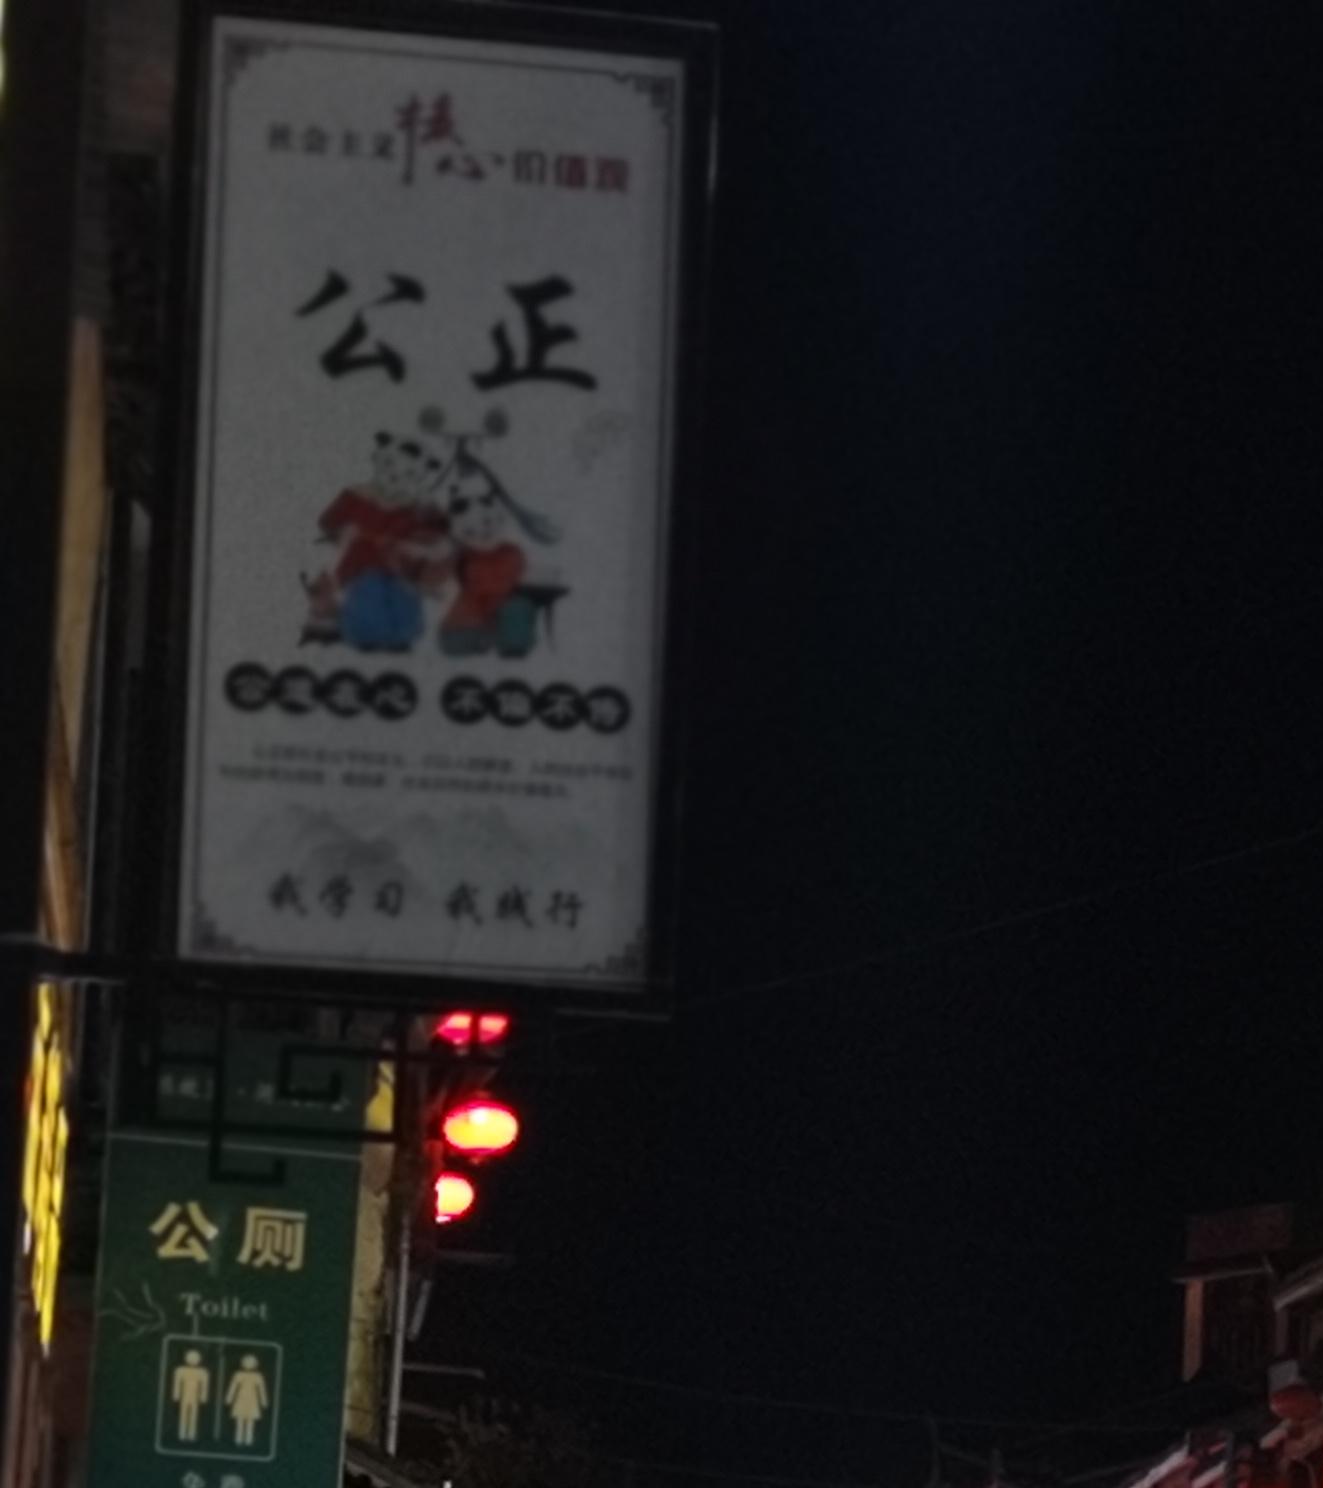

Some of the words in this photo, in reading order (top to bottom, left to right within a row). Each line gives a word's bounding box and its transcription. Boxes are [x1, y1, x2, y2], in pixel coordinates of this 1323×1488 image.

[294, 267, 598, 391] 公正
[148, 1199, 308, 1273] 公厕
[178, 1291, 270, 1322] Toilet
